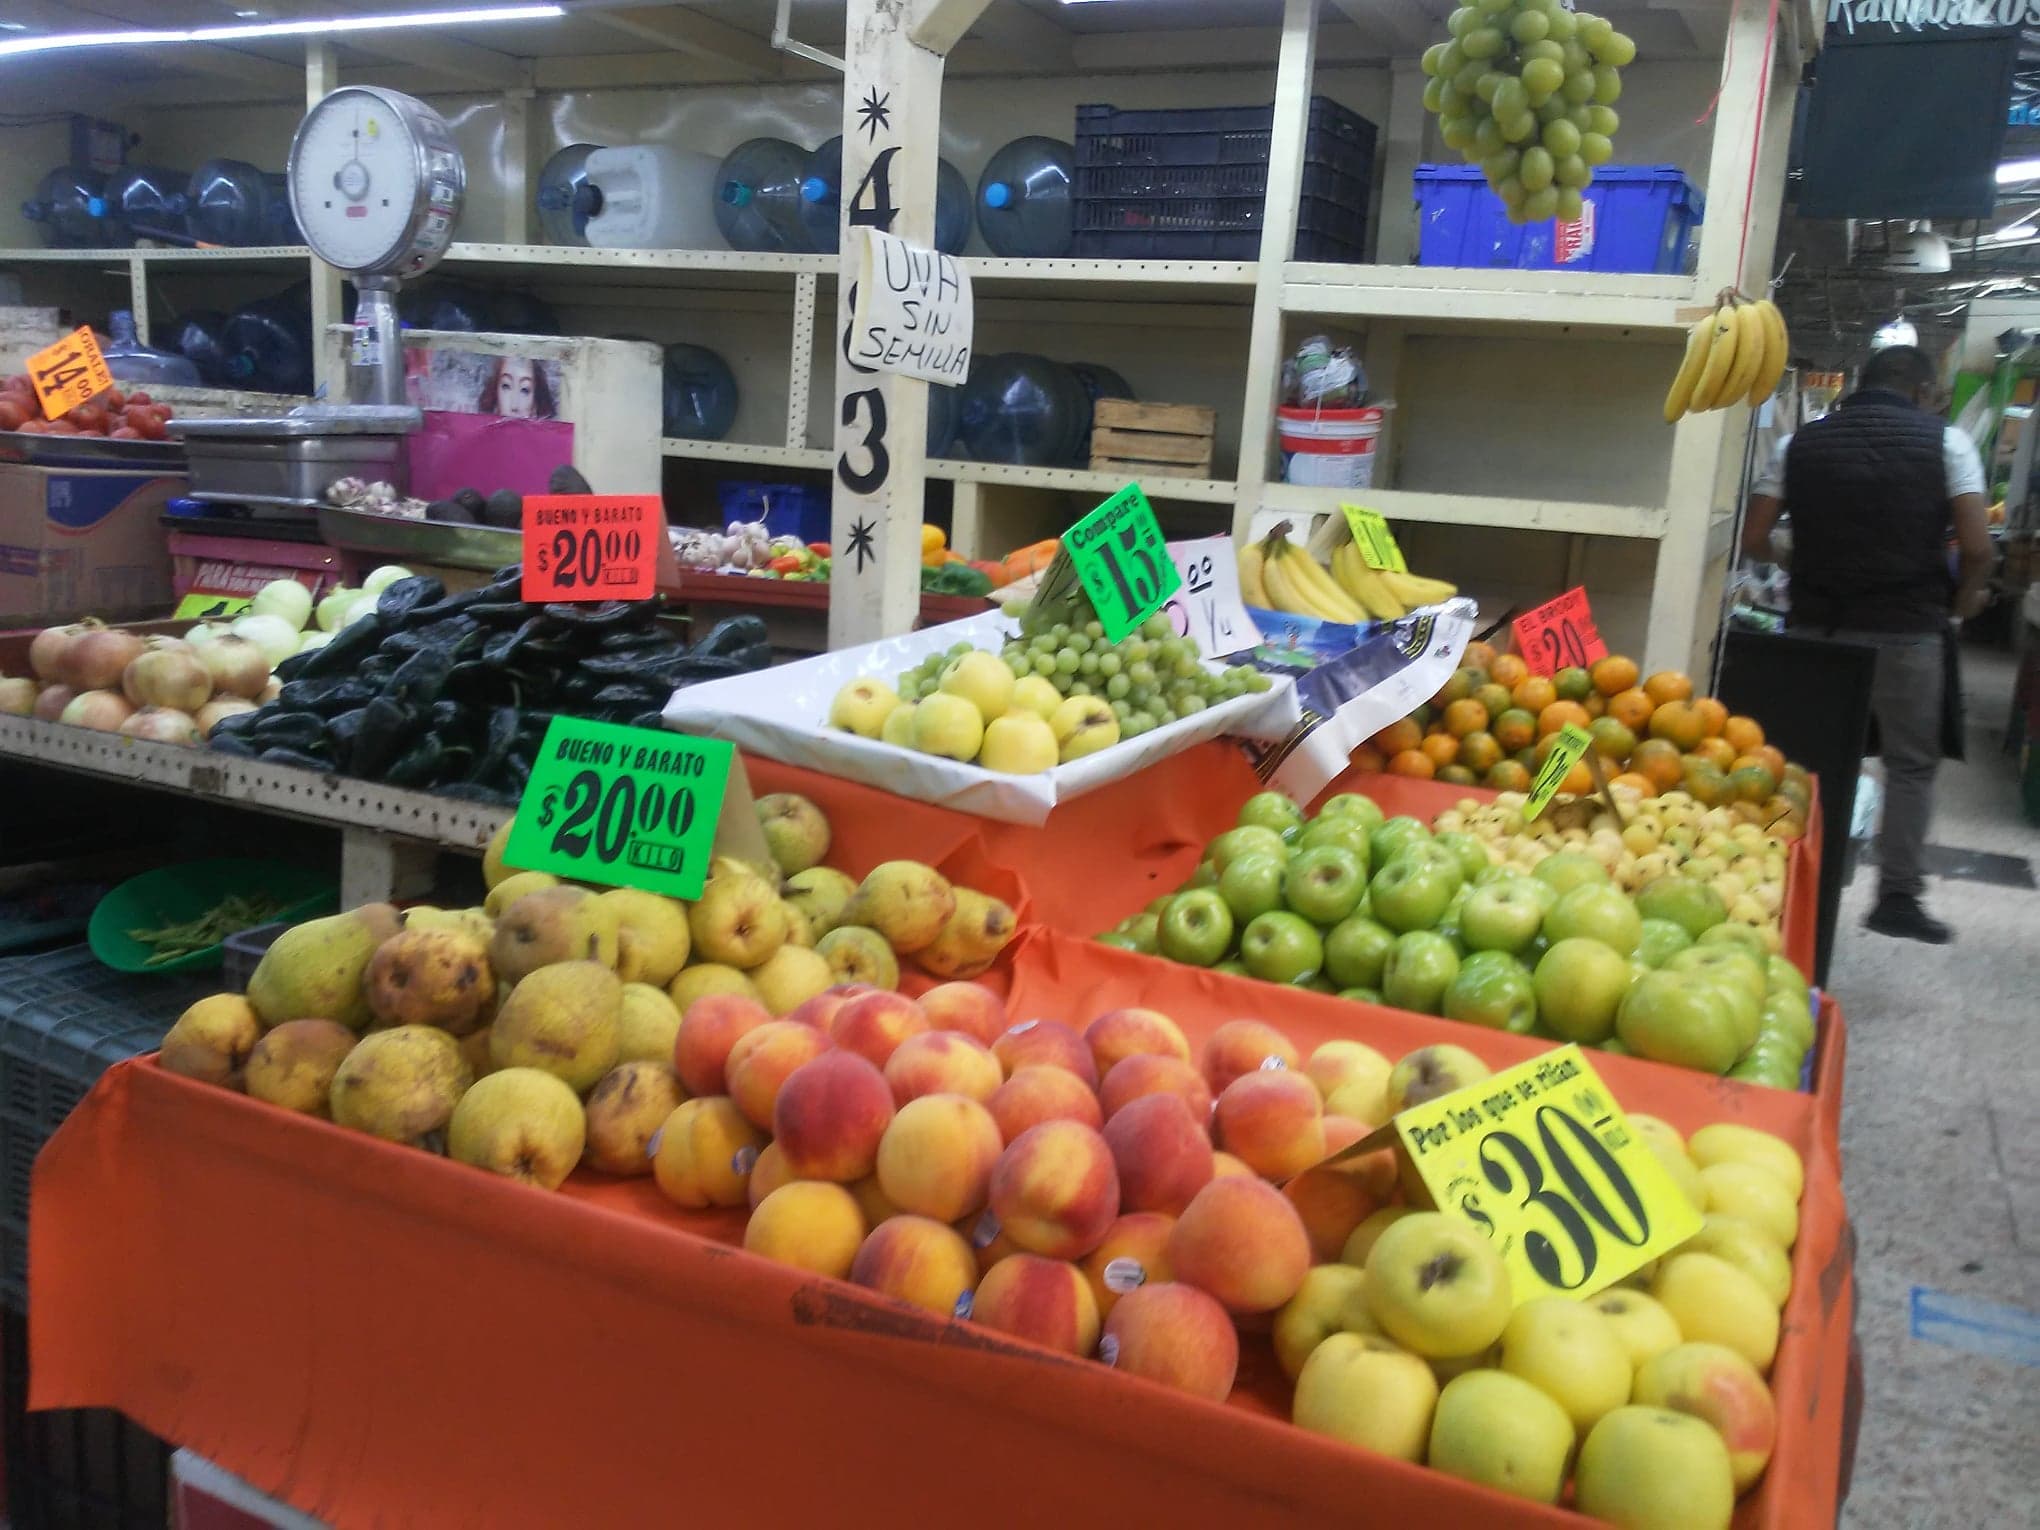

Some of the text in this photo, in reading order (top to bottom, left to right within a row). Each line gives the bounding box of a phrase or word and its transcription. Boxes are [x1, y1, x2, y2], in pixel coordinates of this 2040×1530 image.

[883, 239, 960, 304] UVA
[902, 301, 951, 336] SIN
[536, 506, 643, 525] BUENO Y BARATO
[1072, 494, 1140, 548] Compare
[556, 738, 705, 777] BUENO Y BARATO
[631, 841, 680, 870] KILO
[1408, 1120, 1453, 1154] Por
